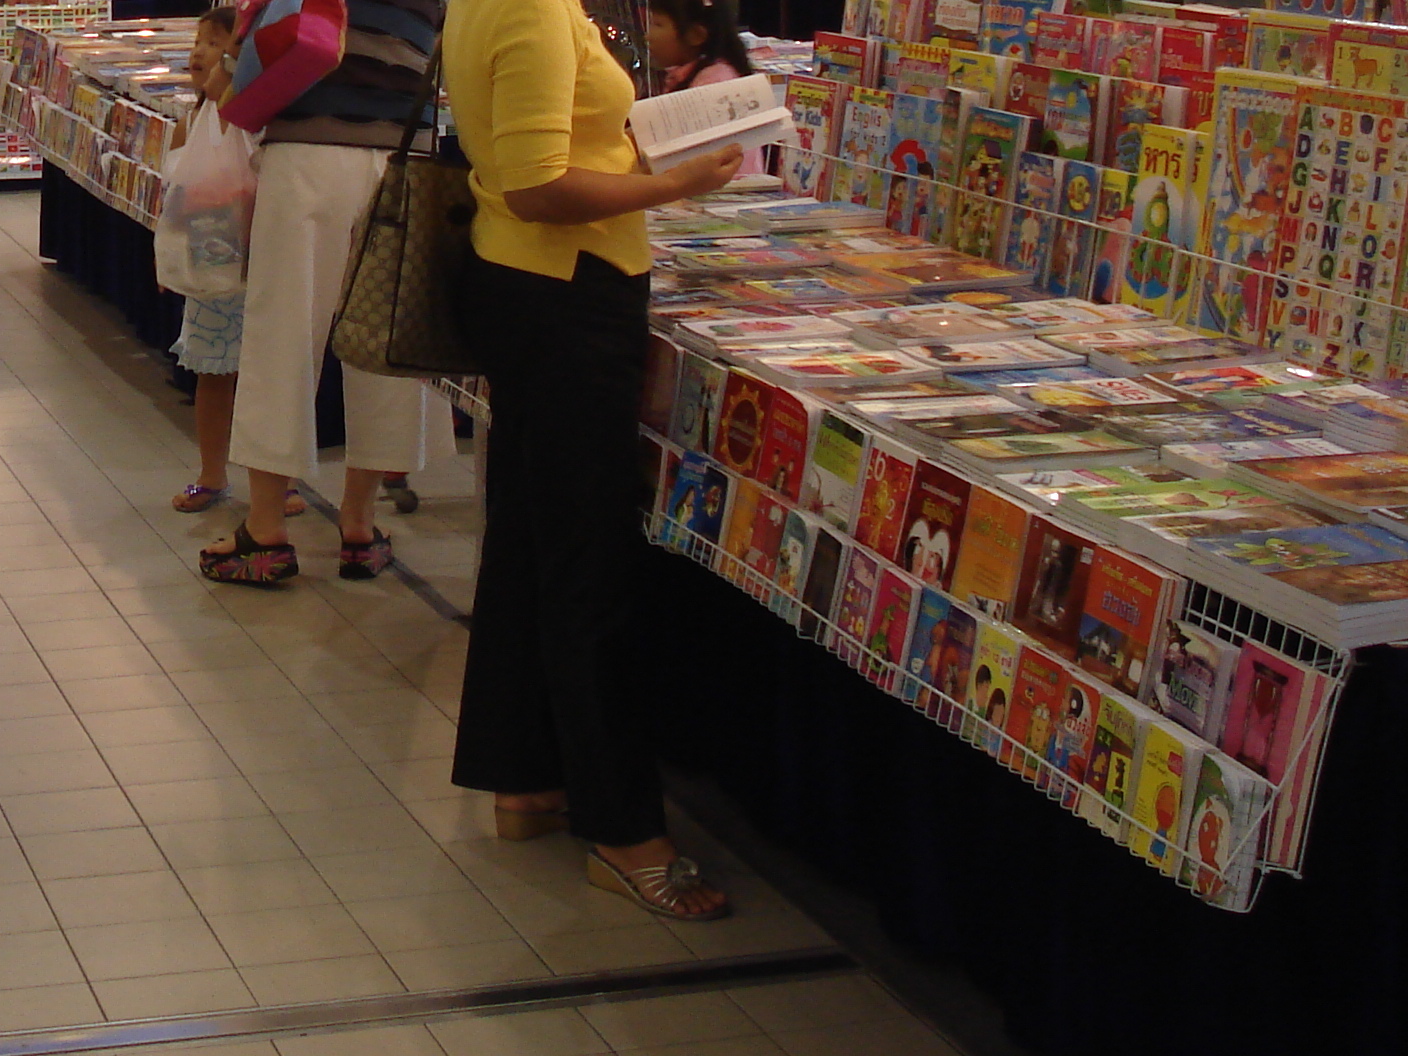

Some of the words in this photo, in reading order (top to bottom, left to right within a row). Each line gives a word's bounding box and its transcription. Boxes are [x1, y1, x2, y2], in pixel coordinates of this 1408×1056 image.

[852, 106, 889, 130] Englis
[1300, 106, 1313, 131] A
[1339, 112, 1353, 137] B
[1378, 117, 1393, 143] C
[1296, 134, 1311, 158] D
[1335, 140, 1352, 166] E
[1373, 147, 1389, 172] F
[1293, 162, 1308, 187] G
[1330, 168, 1347, 194] H
[1373, 176, 1381, 202] I
[1288, 190, 1303, 214] J
[1327, 197, 1342, 224] K
[1365, 204, 1377, 231] L
[1321, 225, 1338, 251] N
[1361, 234, 1378, 259] O
[1280, 245, 1296, 270] P
[1319, 254, 1335, 280] Q
[1355, 261, 1374, 290] R
[1275, 273, 1290, 299] S
[1272, 300, 1287, 325] V
[1323, 343, 1340, 370] Z
